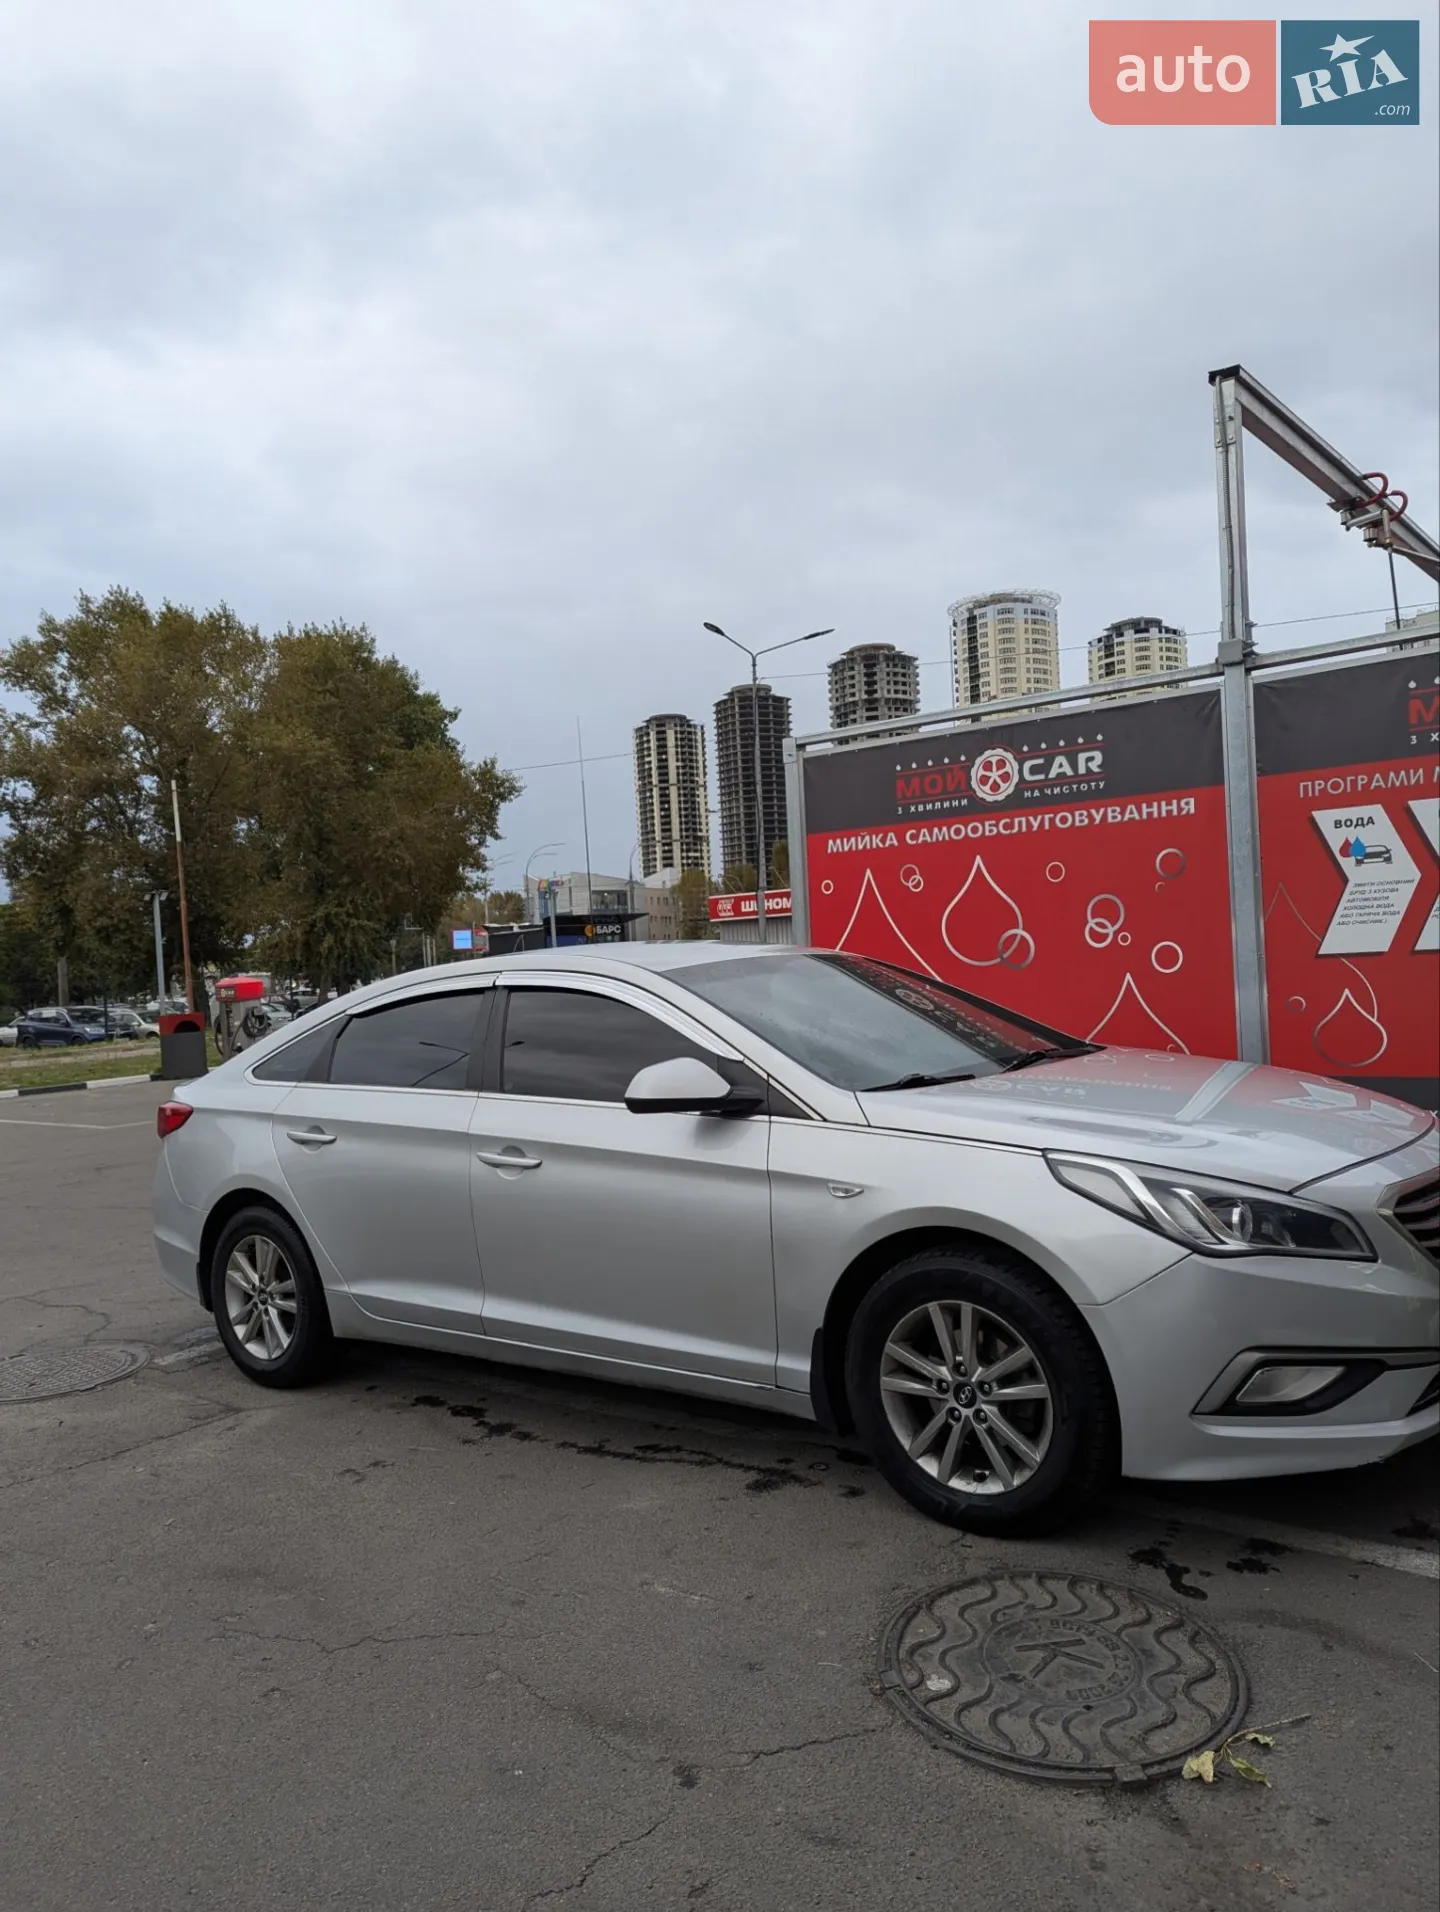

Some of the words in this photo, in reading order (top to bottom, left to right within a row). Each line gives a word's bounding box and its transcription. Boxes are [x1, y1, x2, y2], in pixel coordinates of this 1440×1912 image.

[896, 765, 967, 798] МОЙ
[1023, 750, 1104, 781] CAR
[1299, 768, 1424, 798] ПРОГРАМИ
[910, 798, 968, 813] ХВИЛИНИ
[1024, 788, 1040, 798] НА
[1044, 781, 1105, 797] ЧИСТОТУ
[827, 829, 898, 854] МИЙКА
[905, 797, 1195, 846] САМООБСЛУГОВУВАННЯ
[1333, 816, 1375, 829] ВОДА
[596, 925, 622, 934] БАРС
